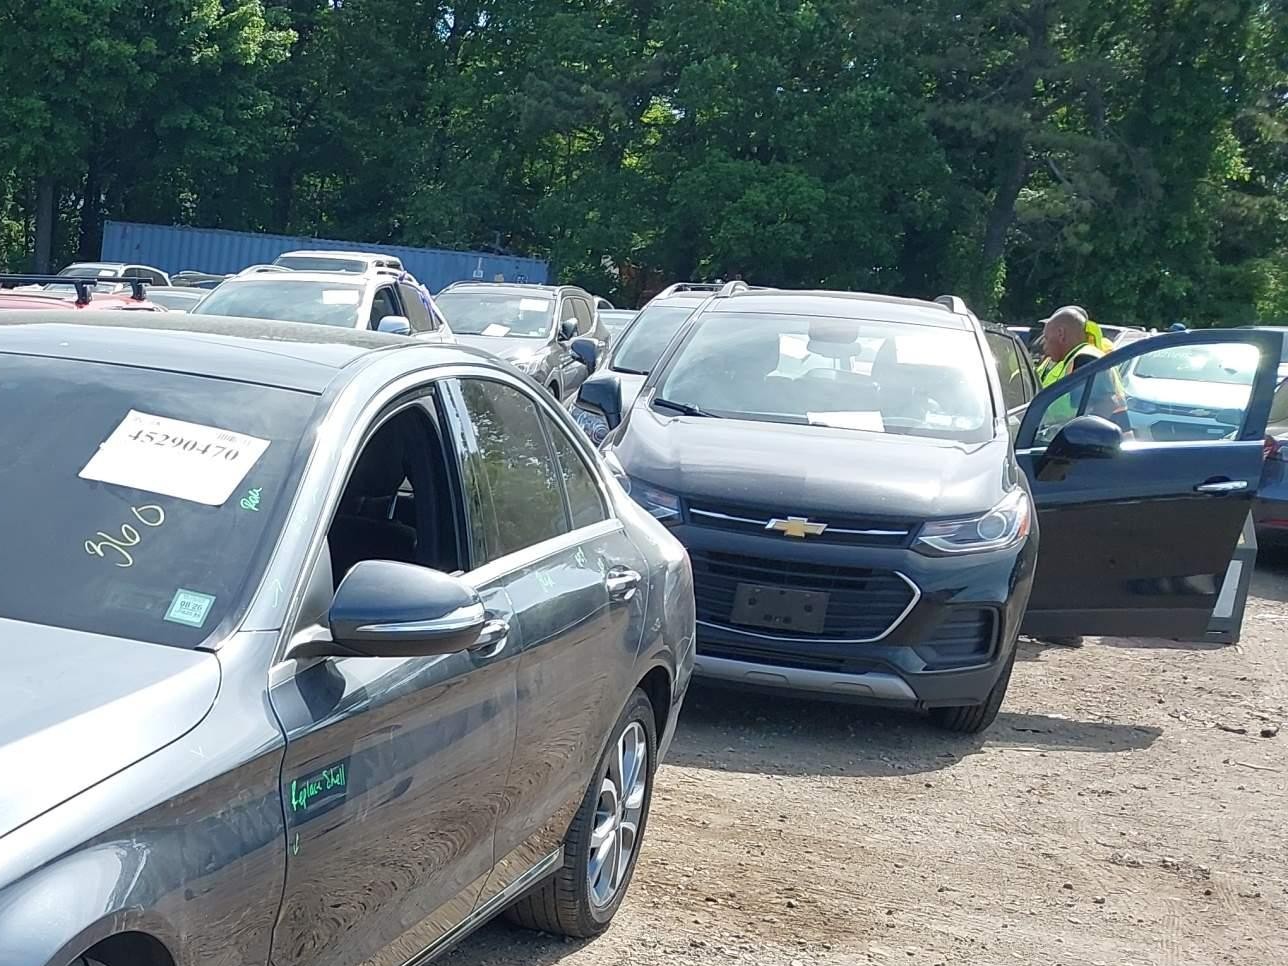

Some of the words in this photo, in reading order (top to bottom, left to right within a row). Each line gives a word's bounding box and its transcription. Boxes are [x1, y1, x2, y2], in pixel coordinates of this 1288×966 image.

[128, 429, 240, 462] 45290470
[84, 504, 166, 568] 360
[322, 763, 346, 790] Shell
